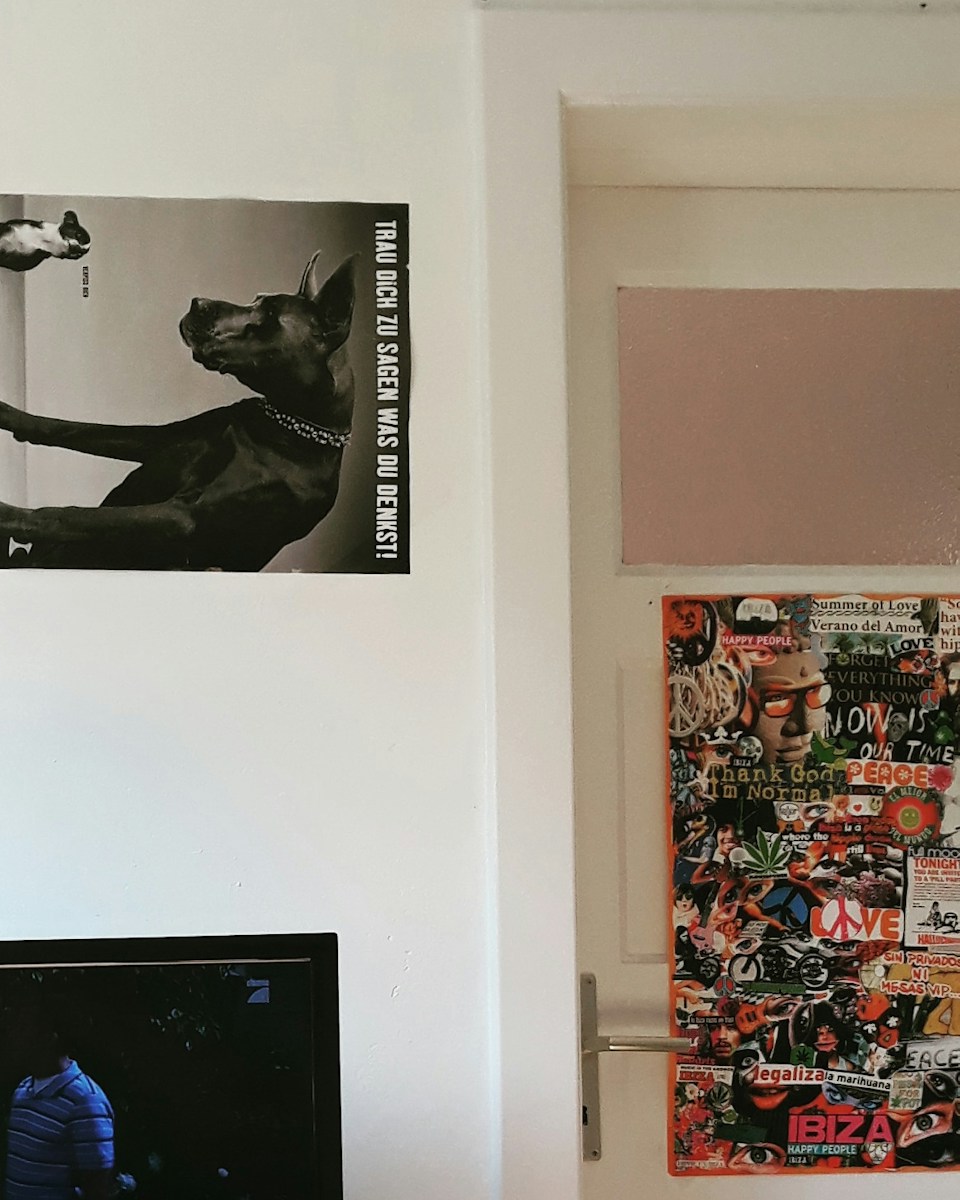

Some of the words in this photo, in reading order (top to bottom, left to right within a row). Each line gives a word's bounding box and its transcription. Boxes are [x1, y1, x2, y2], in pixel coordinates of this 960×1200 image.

[375, 220, 397, 264] TRAU
[376, 314, 398, 336] ZU
[377, 342, 399, 401] SAGEN
[377, 407, 399, 448] WAS
[376, 454, 398, 478] DU
[375, 484, 398, 559] DENKST!
[812, 598, 867, 610] Summer
[872, 599, 884, 610] of
[888, 600, 919, 611] Love
[811, 619, 858, 631] Verano
[862, 620, 881, 632] del
[885, 623, 922, 634] Amor
[722, 635, 753, 646] HAPPY
[757, 636, 793, 646] PEOPLE
[890, 638, 934, 657] LOVE
[825, 703, 893, 738] NOW
[909, 707, 930, 733] IS
[860, 742, 895, 761] OUR
[906, 740, 955, 763] TIME
[709, 764, 783, 782] Thank
[790, 764, 836, 783] God
[846, 761, 928, 789] PEACE
[747, 782, 834, 801] Normal
[883, 952, 902, 963] SIN
[911, 968, 929, 980] NI
[753, 1064, 825, 1084] legaliza
[825, 1072, 835, 1081] la
[837, 1075, 891, 1090] marihuana
[787, 1114, 894, 1143] IBIZA
[787, 1144, 818, 1154] HAPPY
[822, 1145, 858, 1155] PEOPLE
